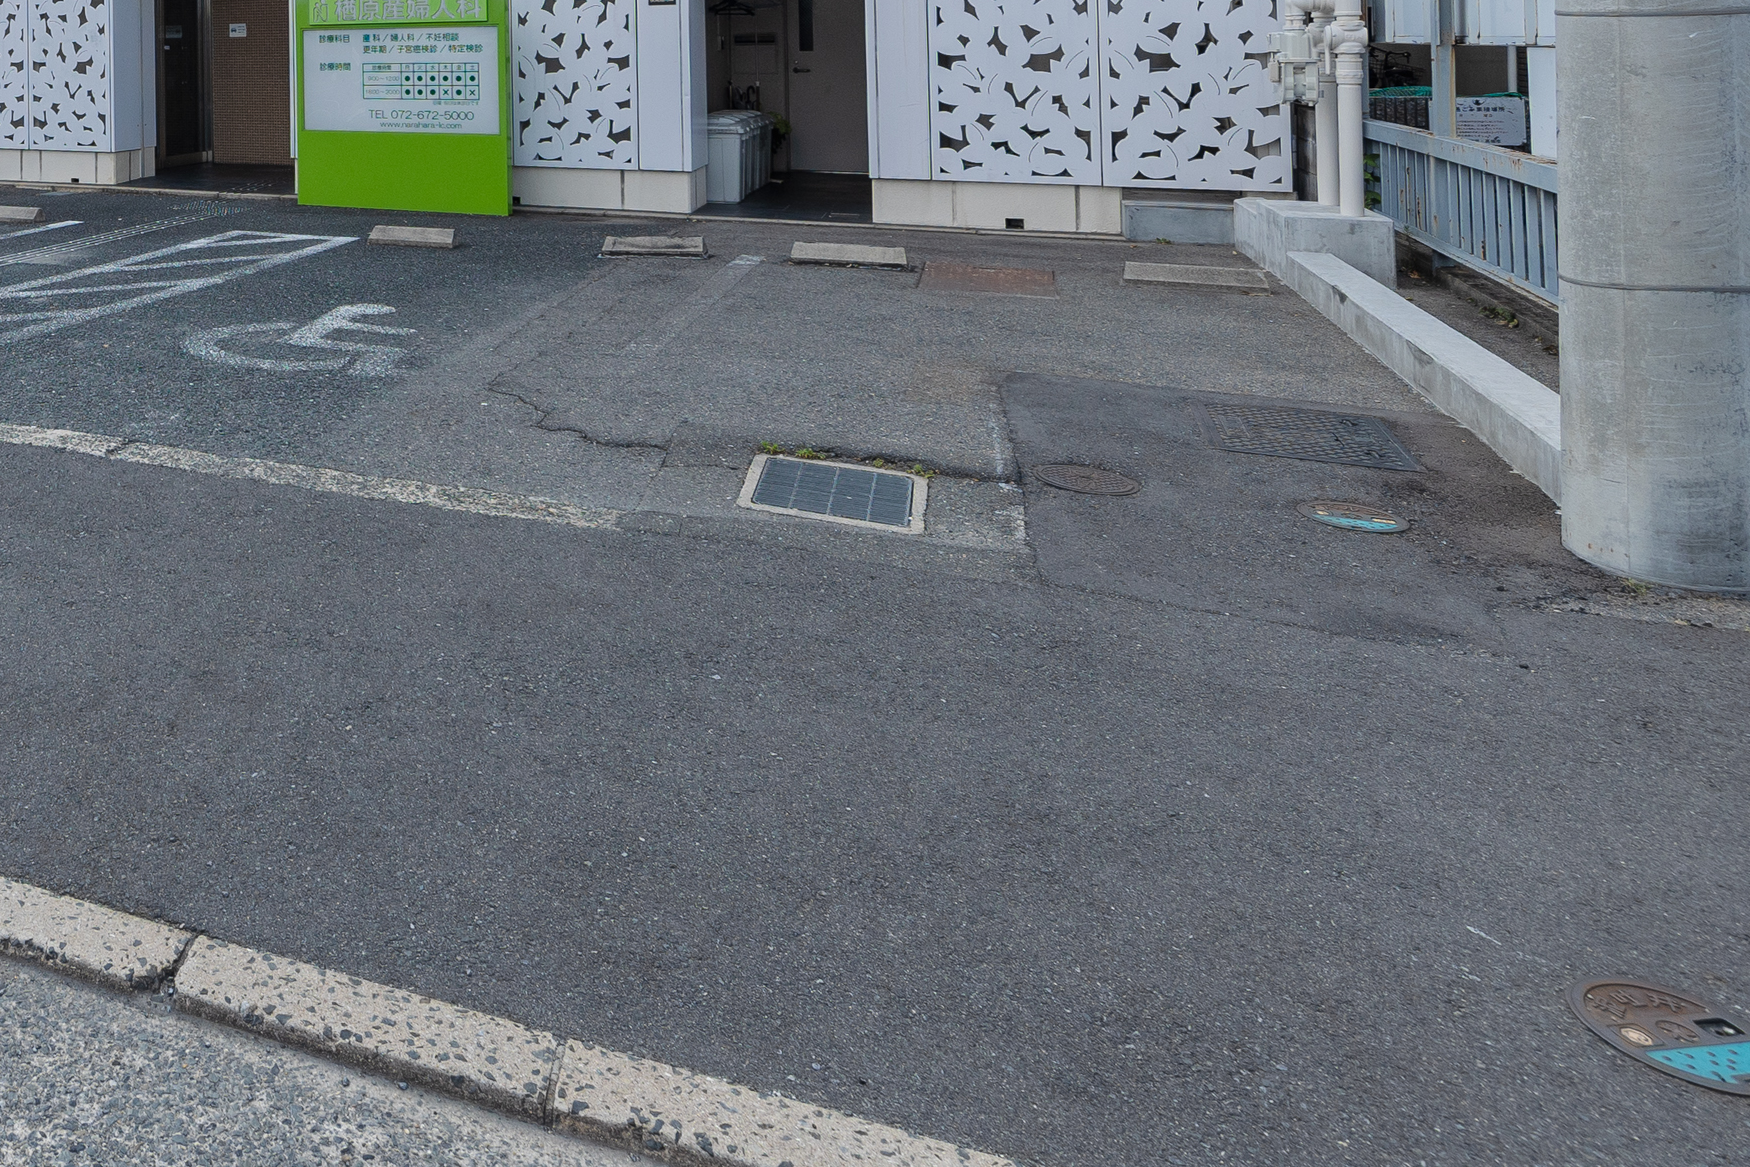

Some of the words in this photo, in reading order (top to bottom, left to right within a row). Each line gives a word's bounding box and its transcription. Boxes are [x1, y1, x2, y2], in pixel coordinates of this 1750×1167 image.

[318, 34, 350, 44] 診療科目
[319, 62, 351, 72] 診療時間
[368, 109, 388, 120] TEL
[390, 110, 475, 121] 072-672-5000
